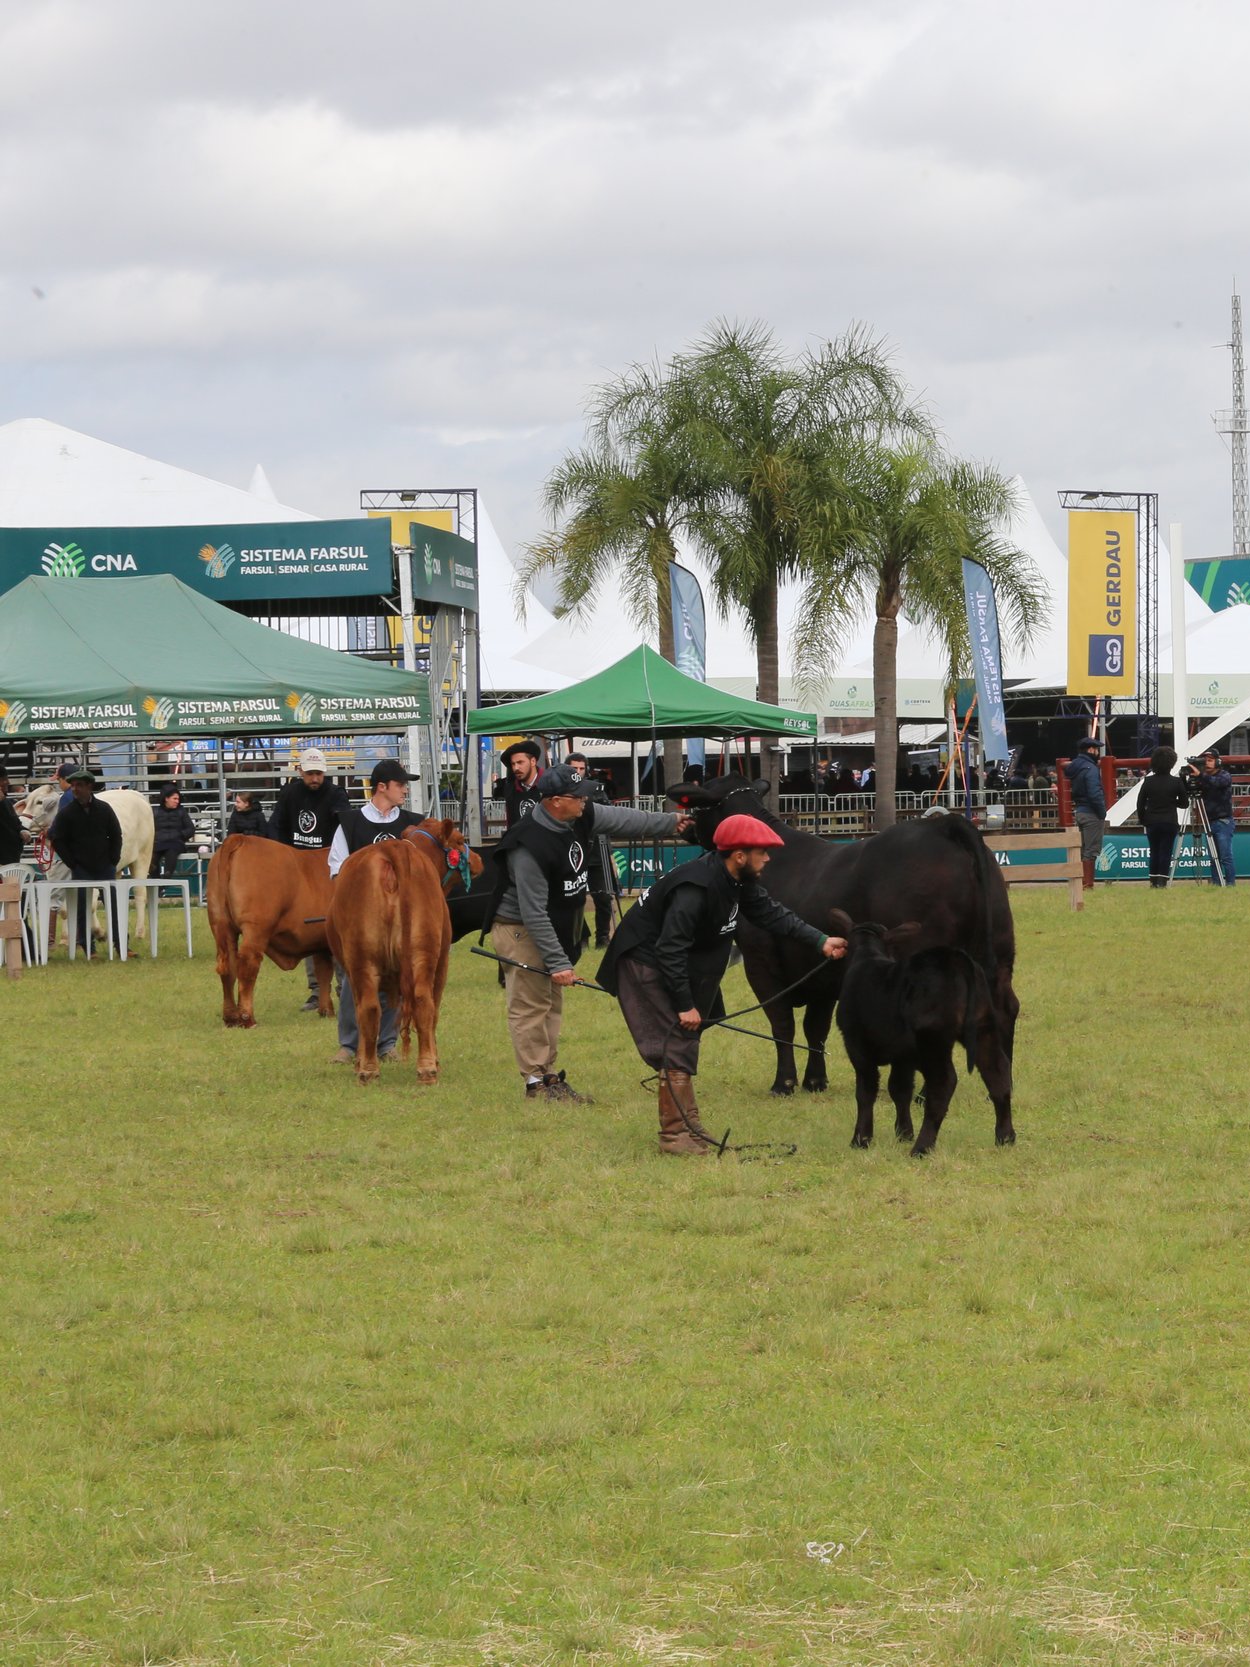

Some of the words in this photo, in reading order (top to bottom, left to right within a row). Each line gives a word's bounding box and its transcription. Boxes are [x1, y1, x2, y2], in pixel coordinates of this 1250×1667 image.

[240, 548, 307, 562] SISTEMA
[310, 546, 369, 560] FARSUL
[91, 554, 137, 572] CNA
[240, 566, 275, 575] FARSUL
[278, 565, 310, 574] SENAR
[313, 564, 338, 573] CASA
[339, 563, 369, 572] RURAL
[1106, 530, 1121, 627] GERDAU
[178, 700, 231, 714] SISTEMA
[234, 698, 280, 712] FARSUL
[320, 698, 371, 710] SISTEMA
[375, 696, 420, 708] FARSUL
[31, 706, 86, 719] SISTEMA
[88, 704, 137, 717] FARSUL
[321, 714, 348, 722] FARSUL
[351, 713, 375, 721] SENAR
[378, 712, 397, 720] CASA
[398, 711, 421, 720] RURAL
[30, 722, 60, 731] FARSUL
[62, 722, 90, 730] SENAR
[92, 721, 112, 729] CASA
[114, 720, 138, 728] RURAL
[179, 718, 206, 726] FARSUL
[210, 716, 235, 725] SENAR
[238, 715, 257, 724] CASA
[259, 714, 282, 722] RURAL
